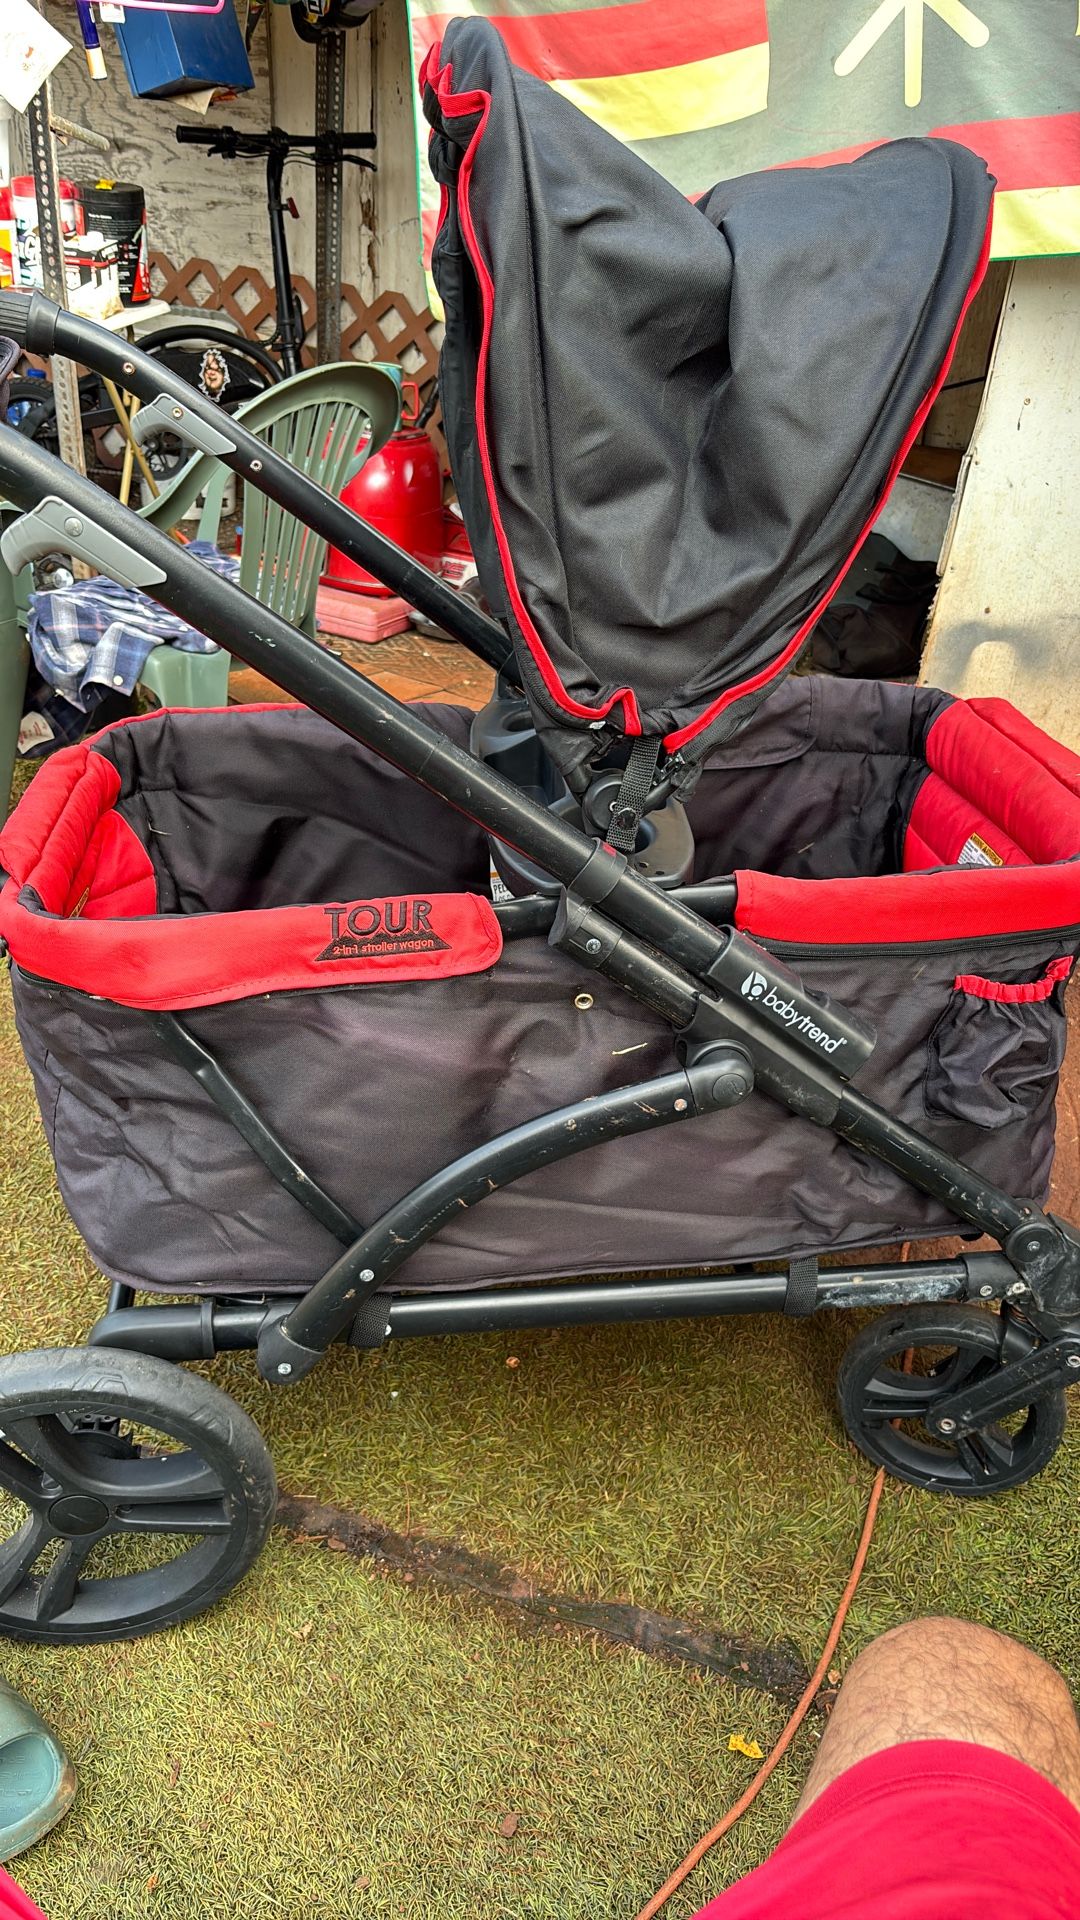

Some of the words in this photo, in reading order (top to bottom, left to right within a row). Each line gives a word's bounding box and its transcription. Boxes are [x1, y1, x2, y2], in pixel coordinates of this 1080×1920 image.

[324, 900, 433, 939] TOUR
[333, 945, 358, 955] 2-in-1
[361, 941, 397, 952] stroller
[399, 939, 434, 950] wagon
[762, 986, 846, 1053] babytrend
